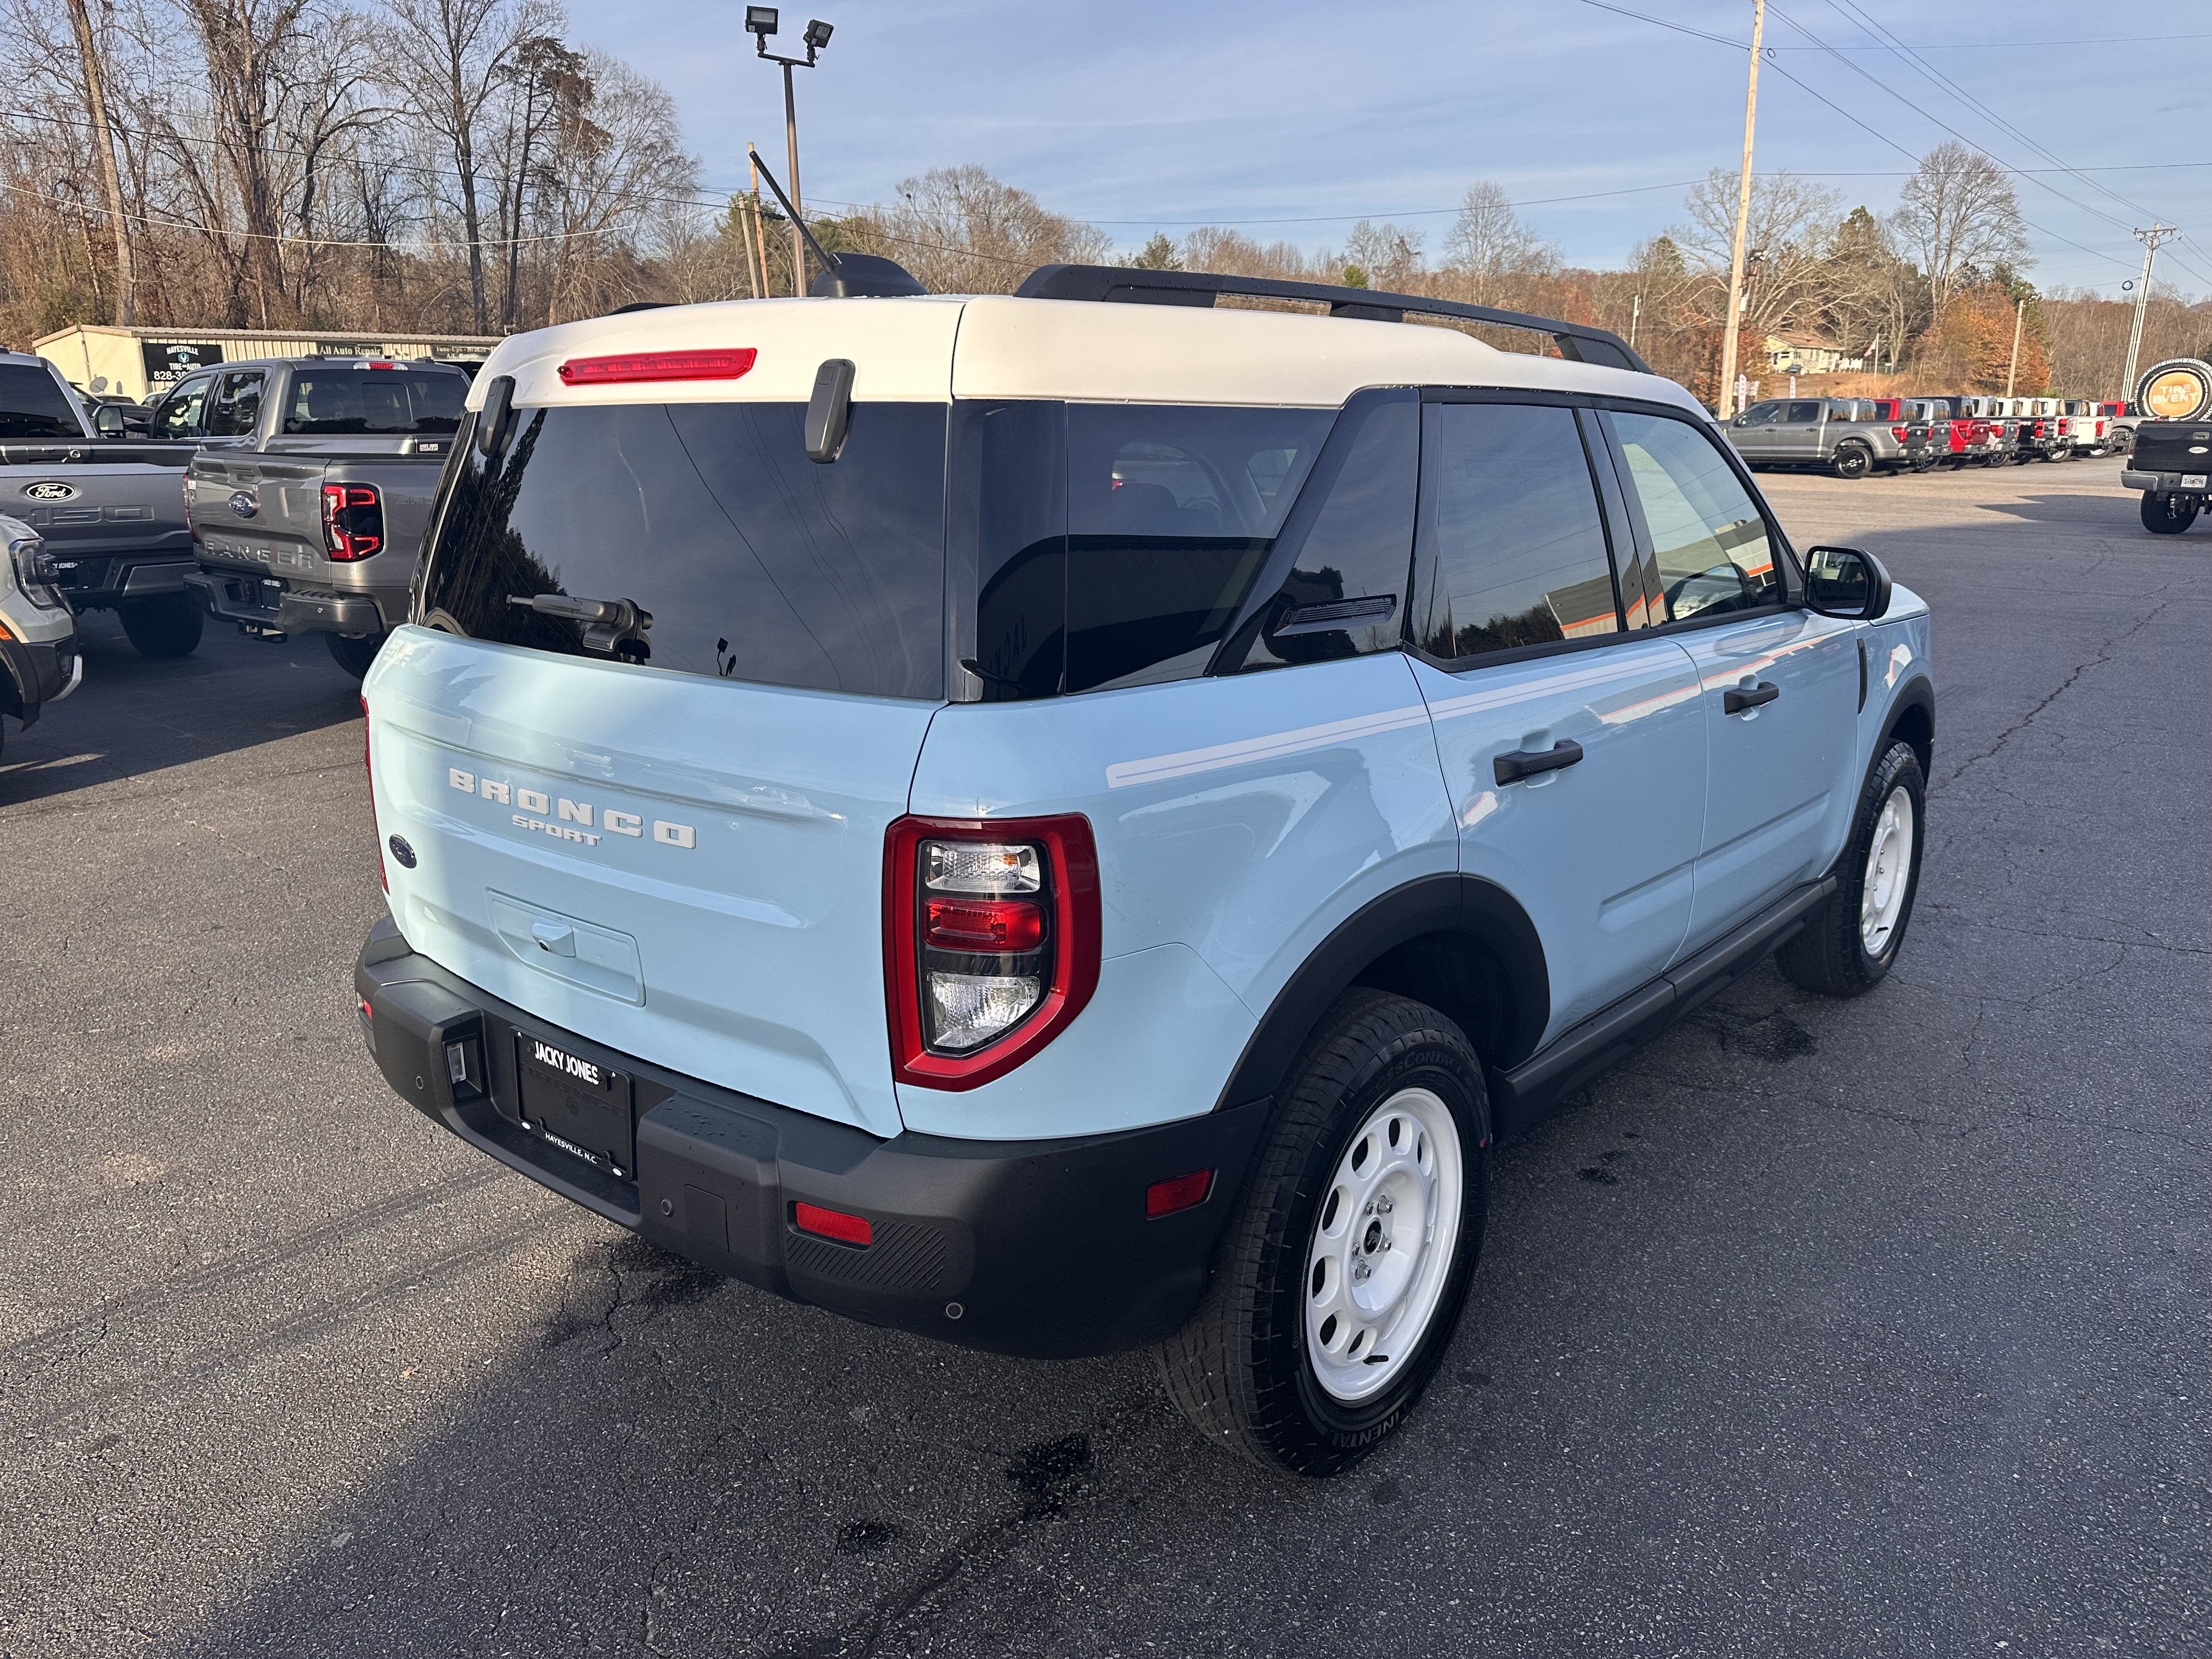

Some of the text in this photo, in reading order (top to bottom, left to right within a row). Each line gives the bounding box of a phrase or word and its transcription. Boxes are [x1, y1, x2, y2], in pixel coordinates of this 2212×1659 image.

[166, 345, 199, 356] HAYESVILLE
[319, 346, 381, 357] All Auto Repair
[2159, 385, 2191, 394] TIRE
[2152, 393, 2199, 404] EVENT
[35, 486, 66, 498] Ford
[394, 495, 433, 504] SPO
[205, 540, 313, 568] RANGER
[449, 767, 696, 849] BRONCO
[512, 814, 602, 847] SPORT
[534, 1040, 600, 1085] JACKY JONES
[545, 1132, 583, 1157] HAYESVILLE,
